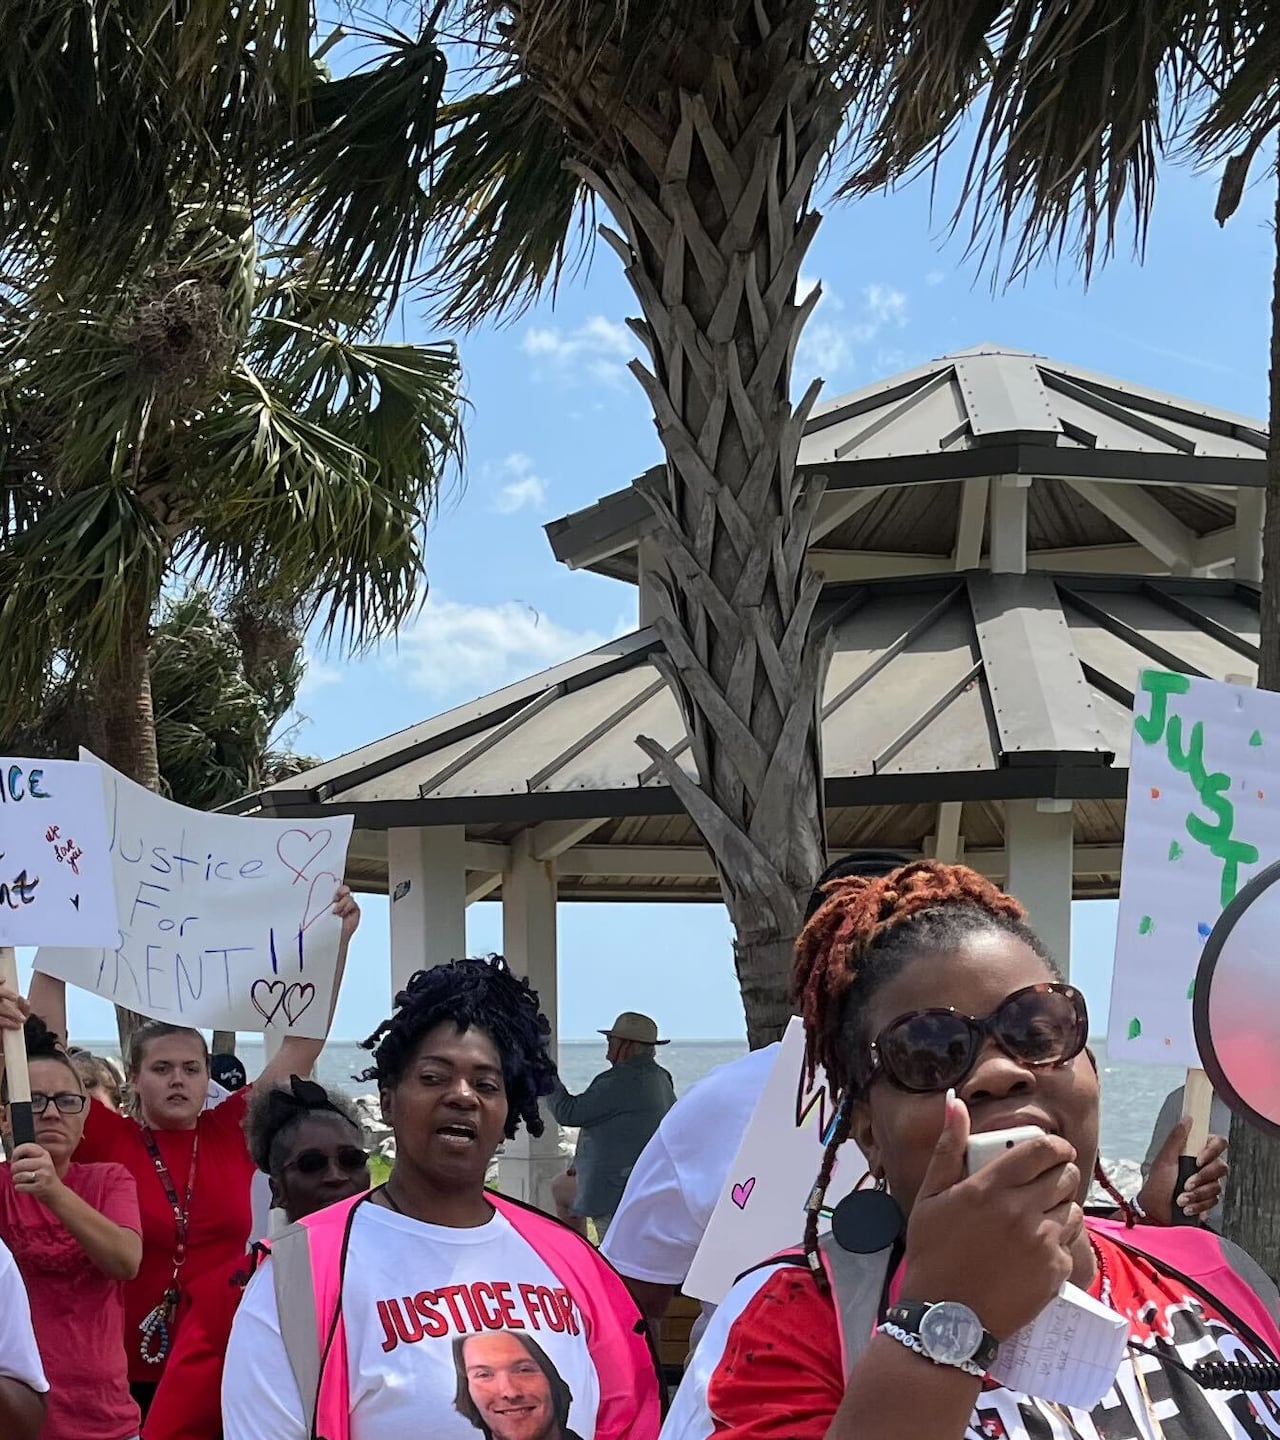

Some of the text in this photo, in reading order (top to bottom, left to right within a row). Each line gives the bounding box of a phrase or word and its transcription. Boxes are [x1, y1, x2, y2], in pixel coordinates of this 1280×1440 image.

[130, 881, 199, 937] For
[376, 1282, 580, 1352] JUSTICE FOR
